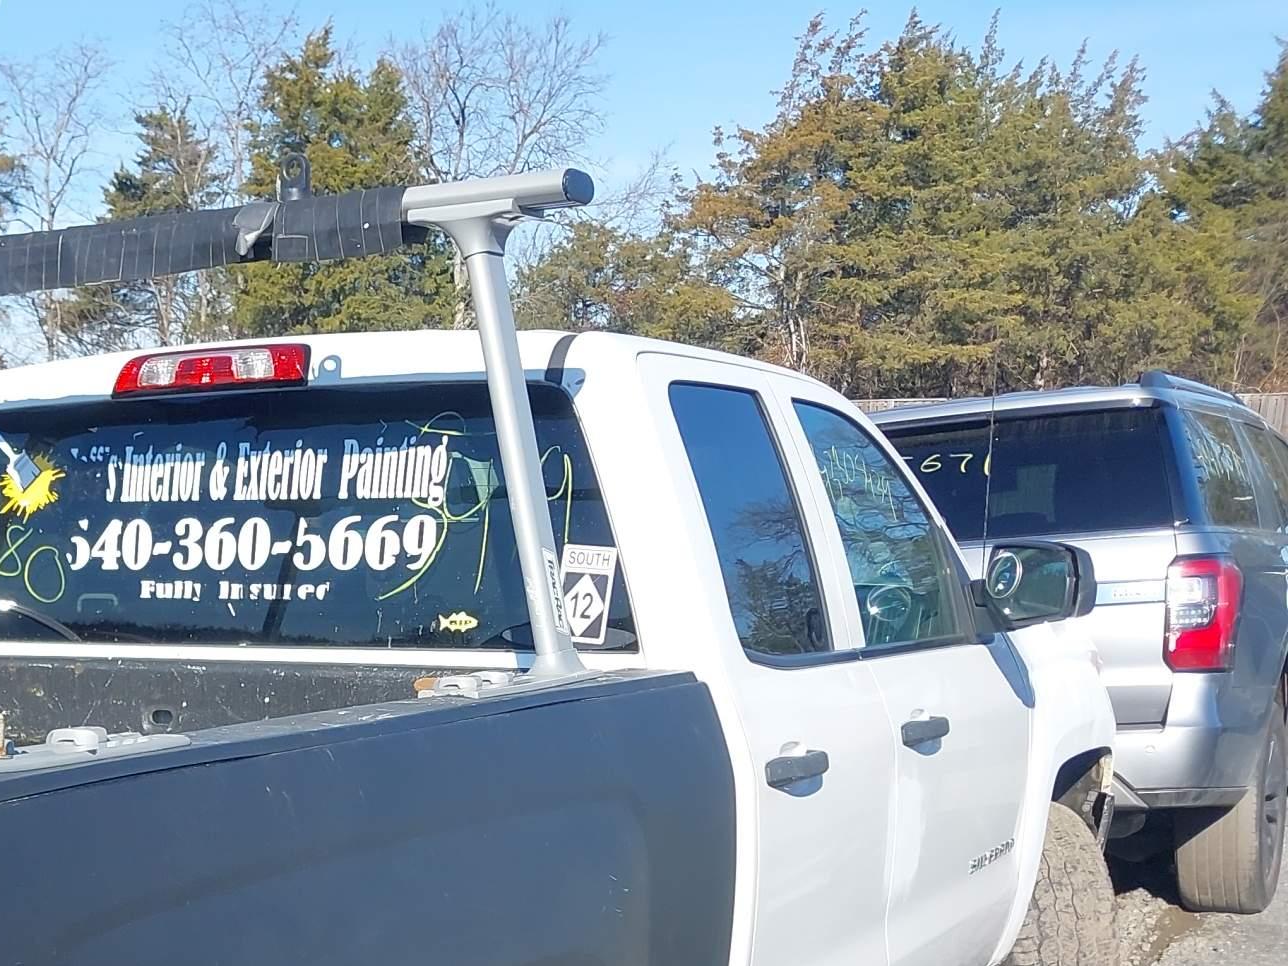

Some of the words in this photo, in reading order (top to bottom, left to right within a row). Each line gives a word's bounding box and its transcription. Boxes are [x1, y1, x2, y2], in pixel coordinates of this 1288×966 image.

[120, 444, 206, 503] Interior
[209, 441, 229, 501] &
[233, 439, 328, 501] Exterior
[338, 435, 448, 507] Painting
[568, 551, 611, 567] SOUTH
[140, 580, 202, 601] Fully
[570, 592, 594, 620] 12
